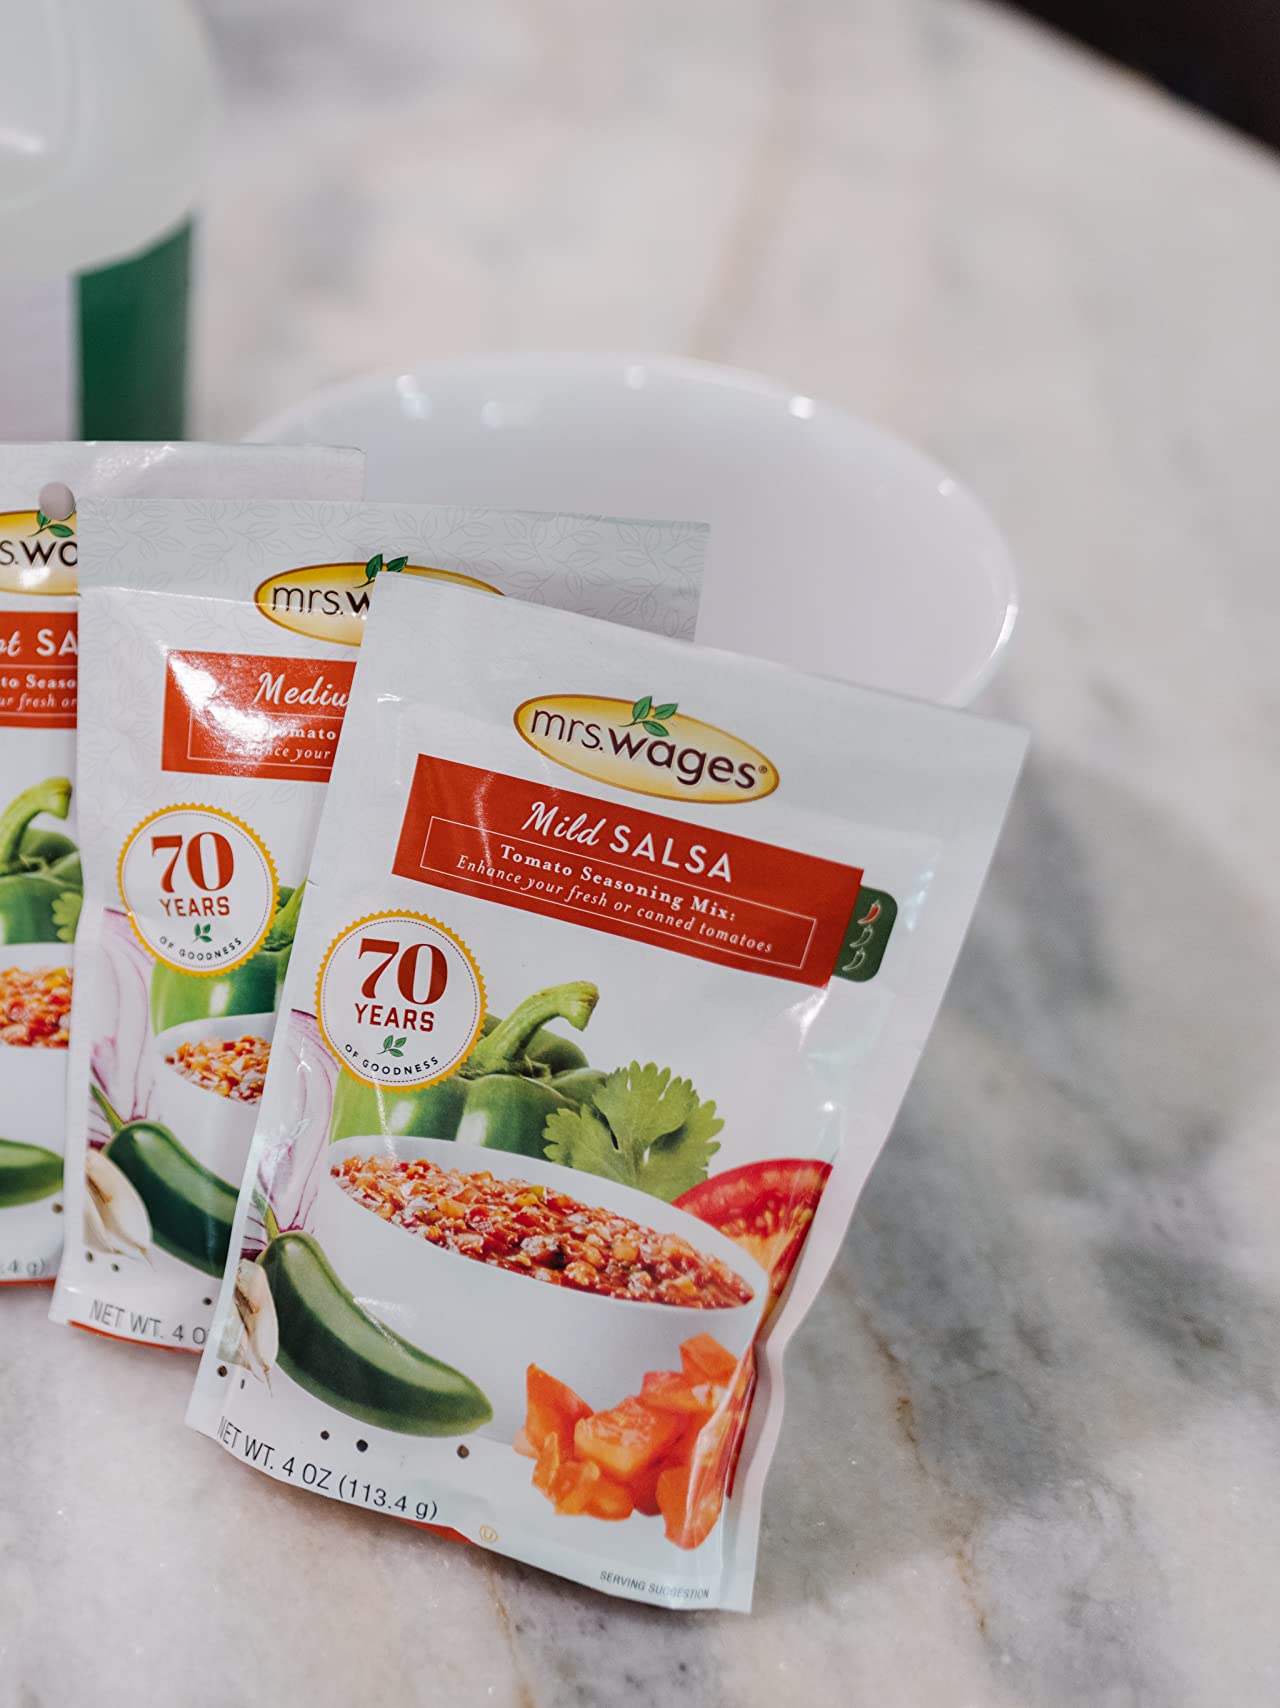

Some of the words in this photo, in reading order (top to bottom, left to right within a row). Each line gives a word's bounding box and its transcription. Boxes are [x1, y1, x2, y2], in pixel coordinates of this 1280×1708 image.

[17, 692, 55, 712] fresh
[290, 748, 331, 762] your
[521, 801, 607, 846] Mild
[609, 825, 732, 883] SALSA
[151, 832, 234, 893] 70
[501, 844, 573, 876] Tomato
[580, 866, 684, 911] Seasoning
[690, 895, 737, 922] Mix:
[158, 896, 230, 917] YEARS
[456, 854, 522, 884] Enhance
[520, 877, 564, 895] your
[565, 885, 608, 907] fresh
[614, 901, 632, 913] or
[637, 907, 695, 931] canned
[699, 923, 773, 953] tomatoes
[160, 936, 174, 949] OF
[179, 937, 243, 960] GOODNESS
[358, 938, 448, 1005] 70
[354, 1003, 435, 1032] YEARS
[345, 1044, 359, 1058] OF
[362, 1056, 439, 1075] GOODNESS
[89, 1300, 125, 1326] NET
[130, 1312, 164, 1339] WT.
[172, 1324, 184, 1341] 4
[244, 1435, 275, 1470] WT.
[282, 1457, 295, 1477] 4
[302, 1463, 333, 1490] OZ
[339, 1475, 407, 1512] (113.4
[415, 1501, 438, 1521] g)
[599, 1570, 646, 1592] SERVING
